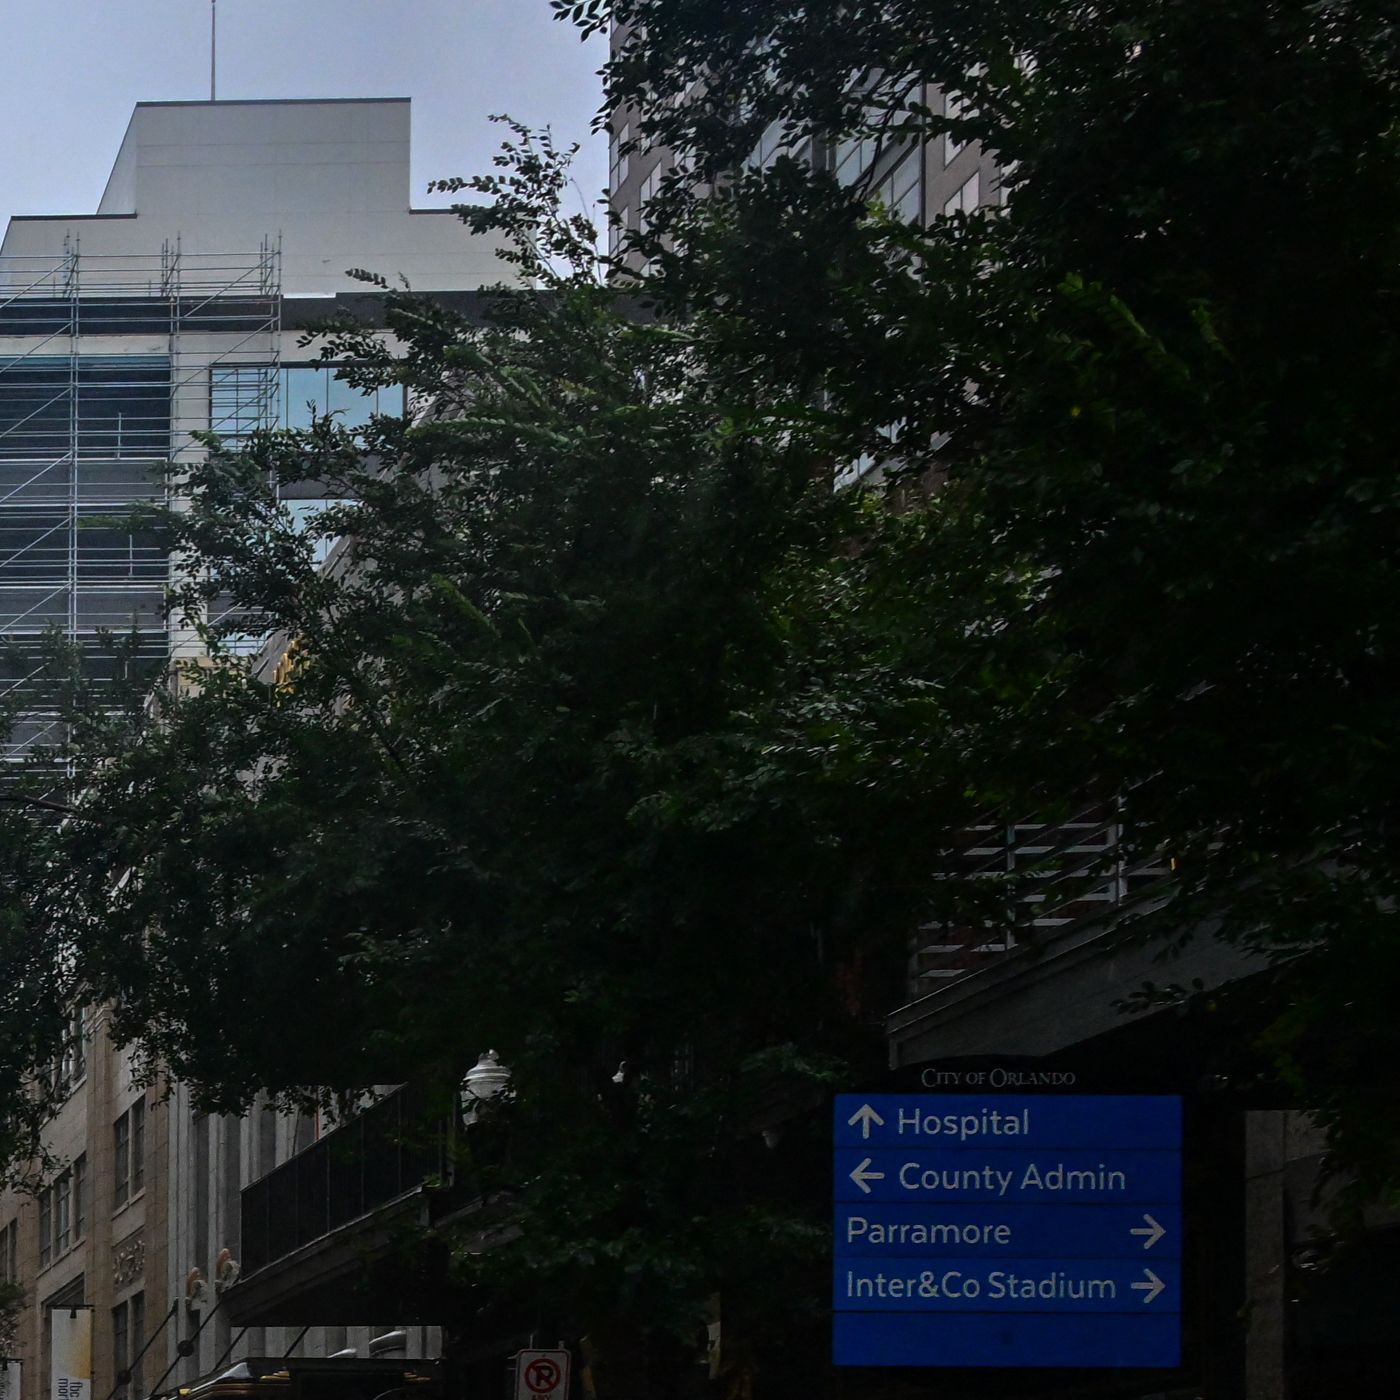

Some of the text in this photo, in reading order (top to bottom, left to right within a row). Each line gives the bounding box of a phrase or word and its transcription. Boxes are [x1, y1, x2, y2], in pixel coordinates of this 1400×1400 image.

[966, 1072, 986, 1085] OF
[989, 1068, 1077, 1088] ORLANDO
[898, 1107, 1029, 1141] Hospital
[899, 1161, 1126, 1197] County Admin
[847, 1215, 1012, 1245] Parramore
[846, 1270, 1117, 1299] Inter&Co Stadium
[69, 1381, 83, 1398] fbc
